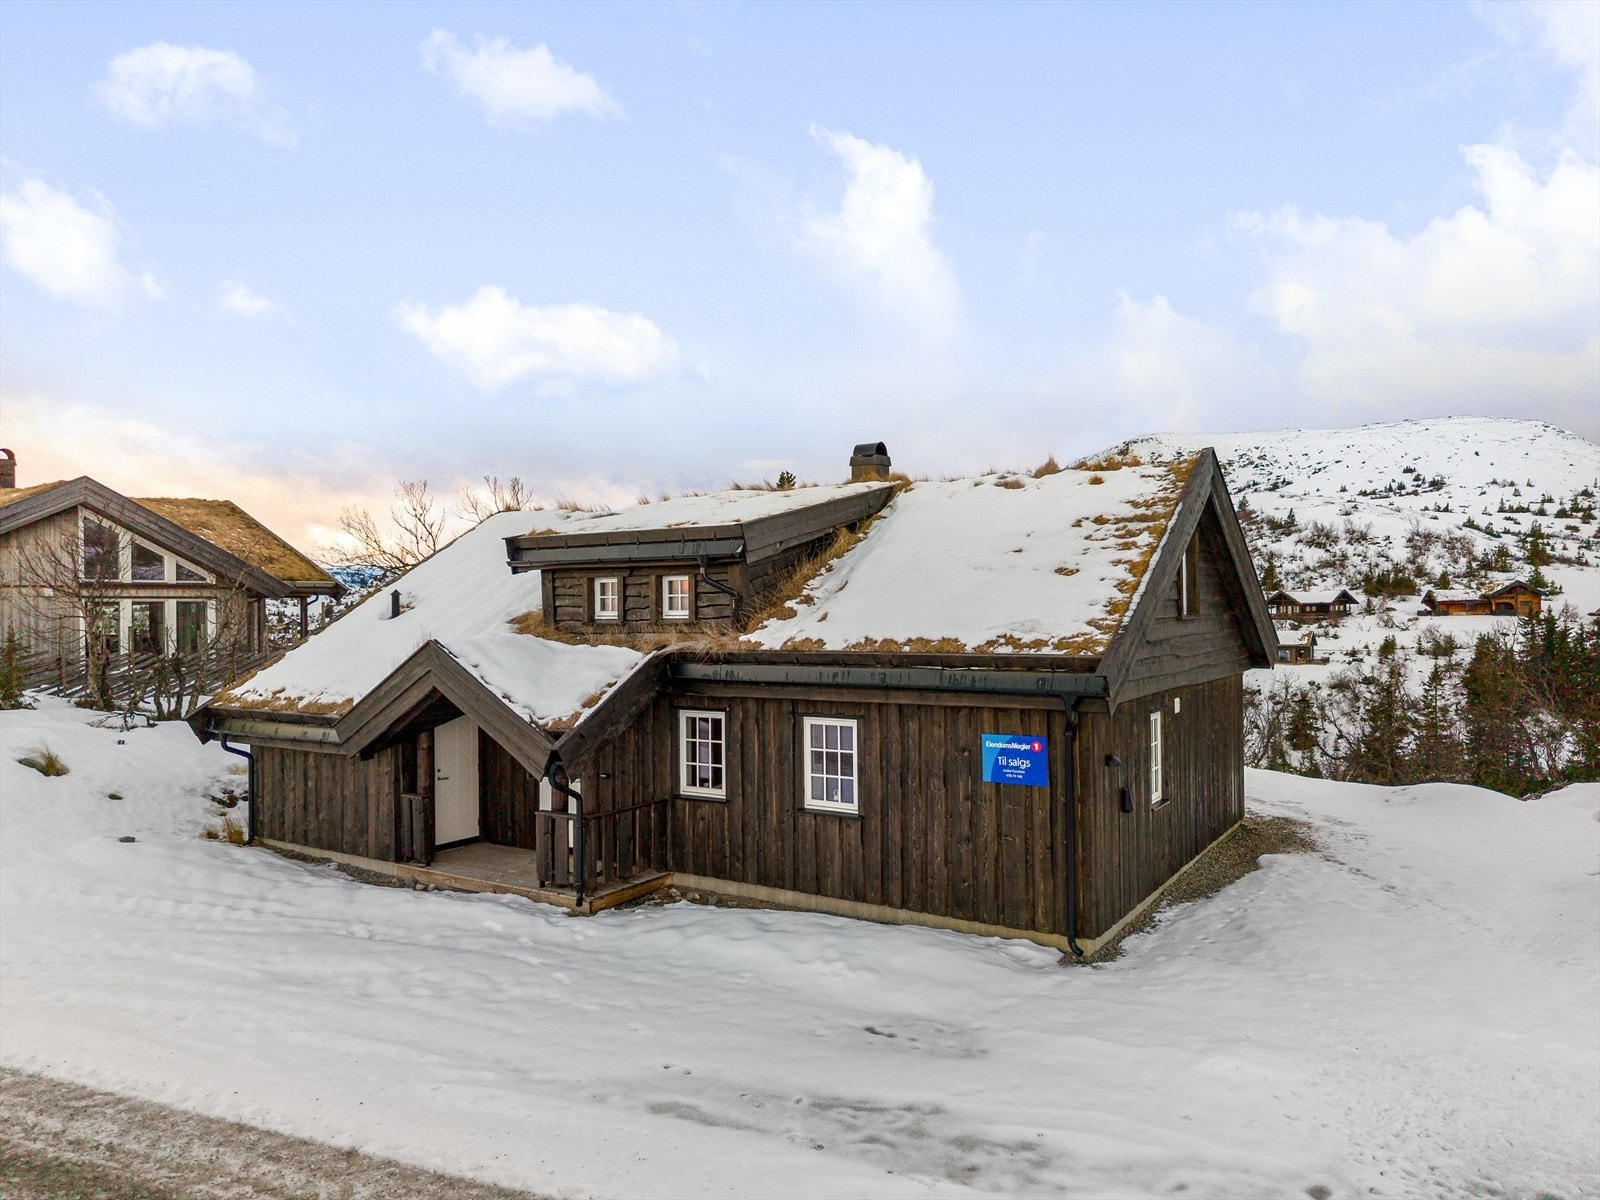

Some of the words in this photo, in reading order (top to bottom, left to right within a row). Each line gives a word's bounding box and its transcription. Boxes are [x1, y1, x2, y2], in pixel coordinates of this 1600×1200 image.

[985, 740, 1031, 751] EiendomsMegler
[997, 756, 1007, 766] Til
[1008, 757, 1031, 769] salgs
